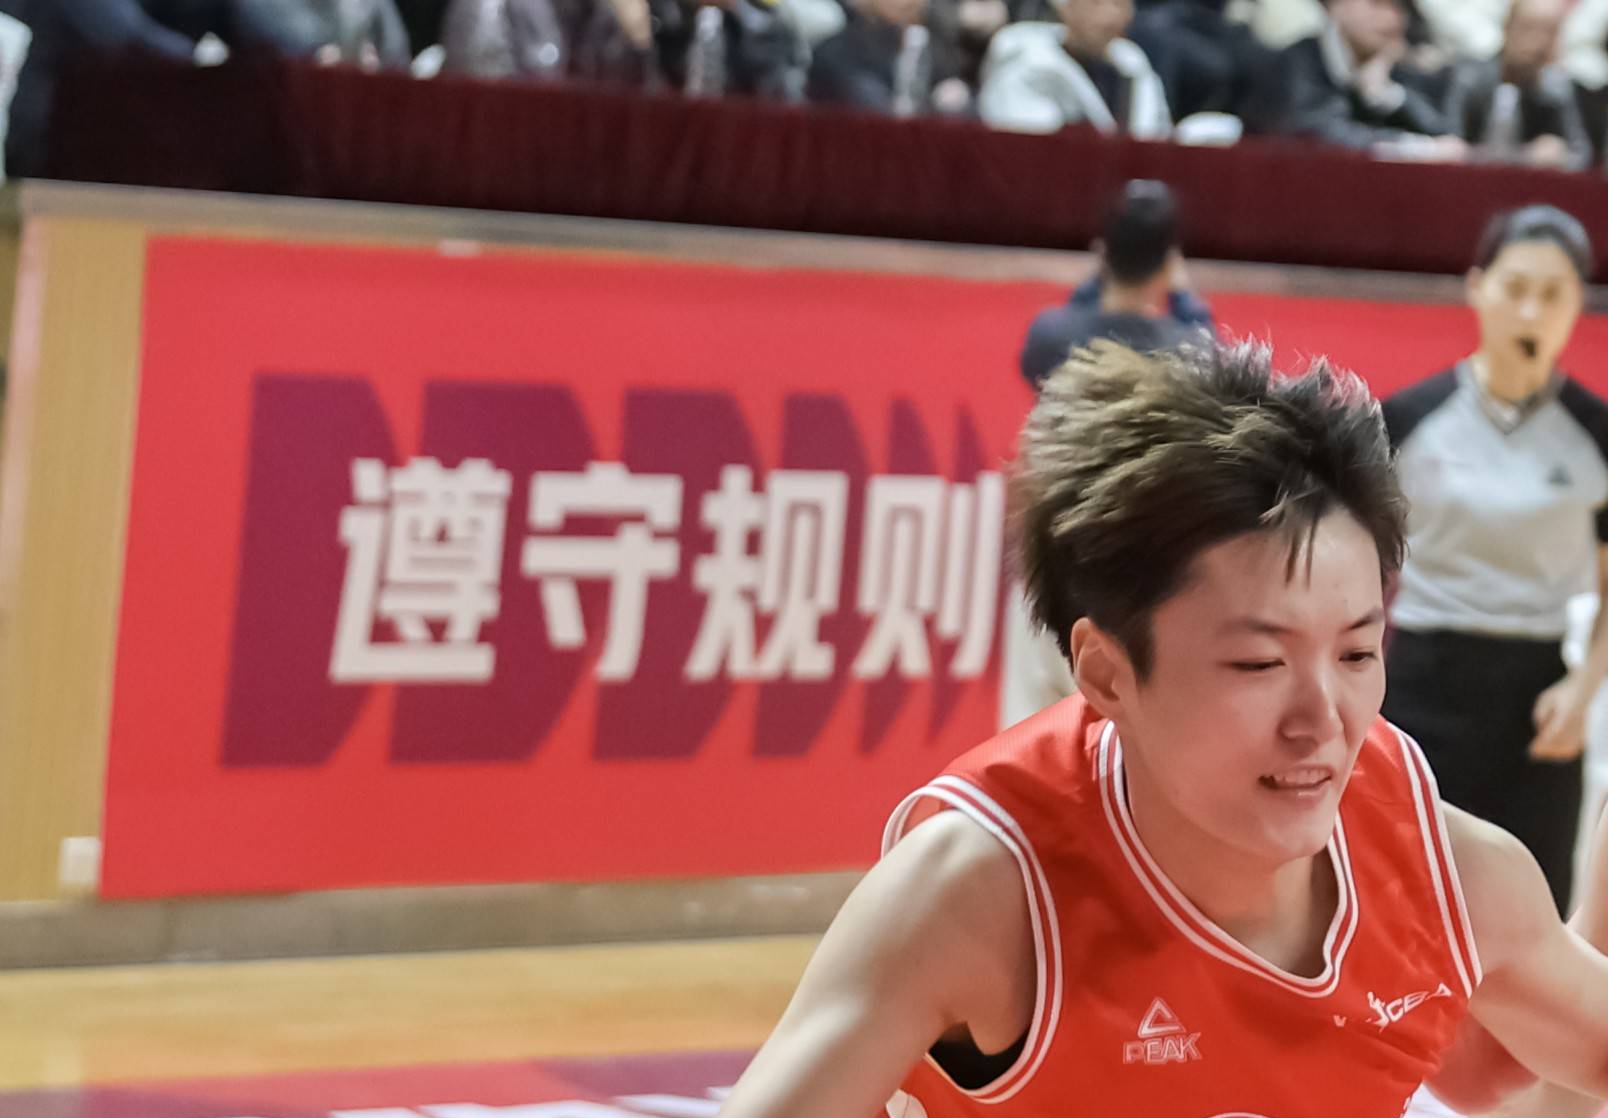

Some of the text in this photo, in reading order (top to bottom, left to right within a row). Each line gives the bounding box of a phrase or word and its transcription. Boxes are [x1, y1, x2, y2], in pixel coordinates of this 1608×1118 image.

[327, 456, 1004, 683] 遵守规则
[1122, 1032, 1202, 1065] PEAK
